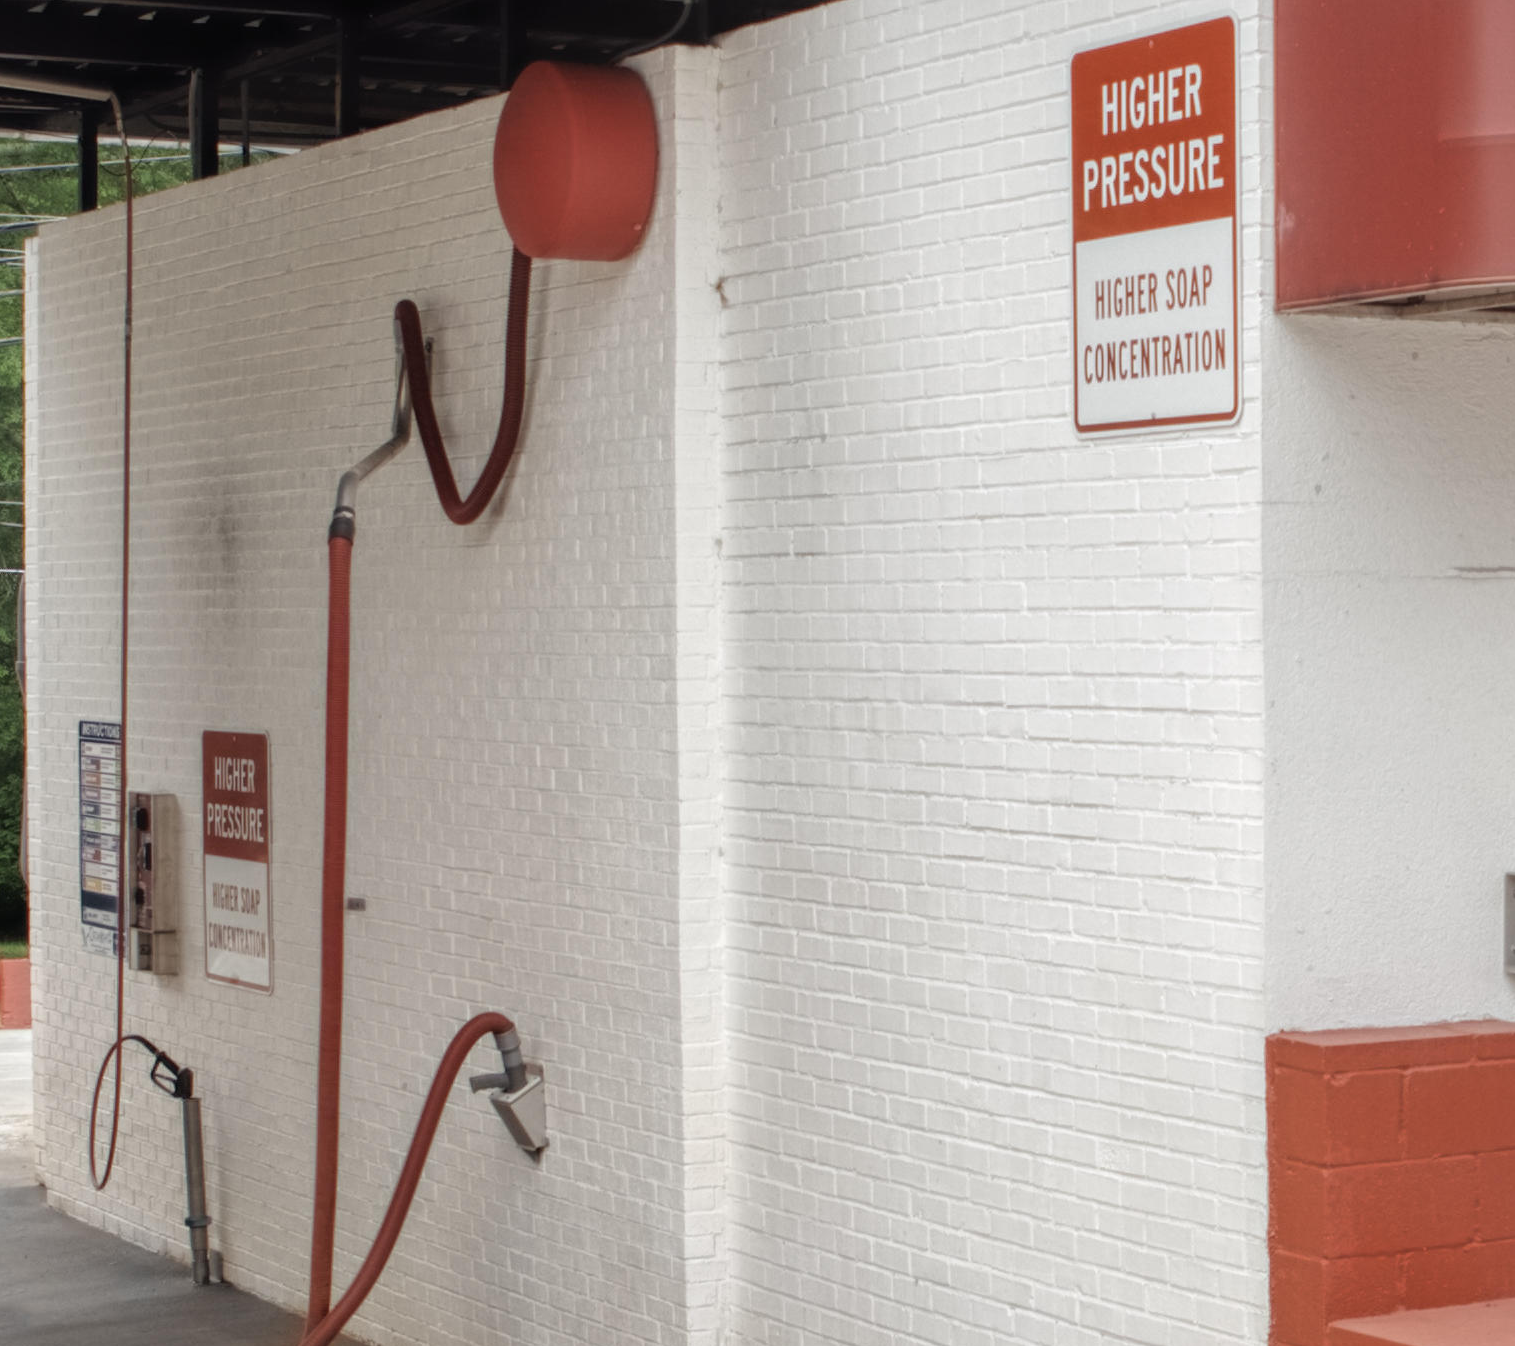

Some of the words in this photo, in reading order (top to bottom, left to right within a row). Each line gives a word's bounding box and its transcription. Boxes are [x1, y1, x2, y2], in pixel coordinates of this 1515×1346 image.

[1102, 63, 1202, 136] HIGHER
[1083, 134, 1225, 212] PRESSURE
[1095, 271, 1158, 320] HIGHER
[1166, 264, 1213, 310] SOAP
[1085, 328, 1227, 384] CONCENTRATION
[214, 756, 255, 793] HIGHER
[207, 802, 264, 843] PRESSURE
[213, 882, 239, 912] HIGHER
[241, 887, 260, 915] SOAP
[209, 922, 266, 959] CONCENTRATION
